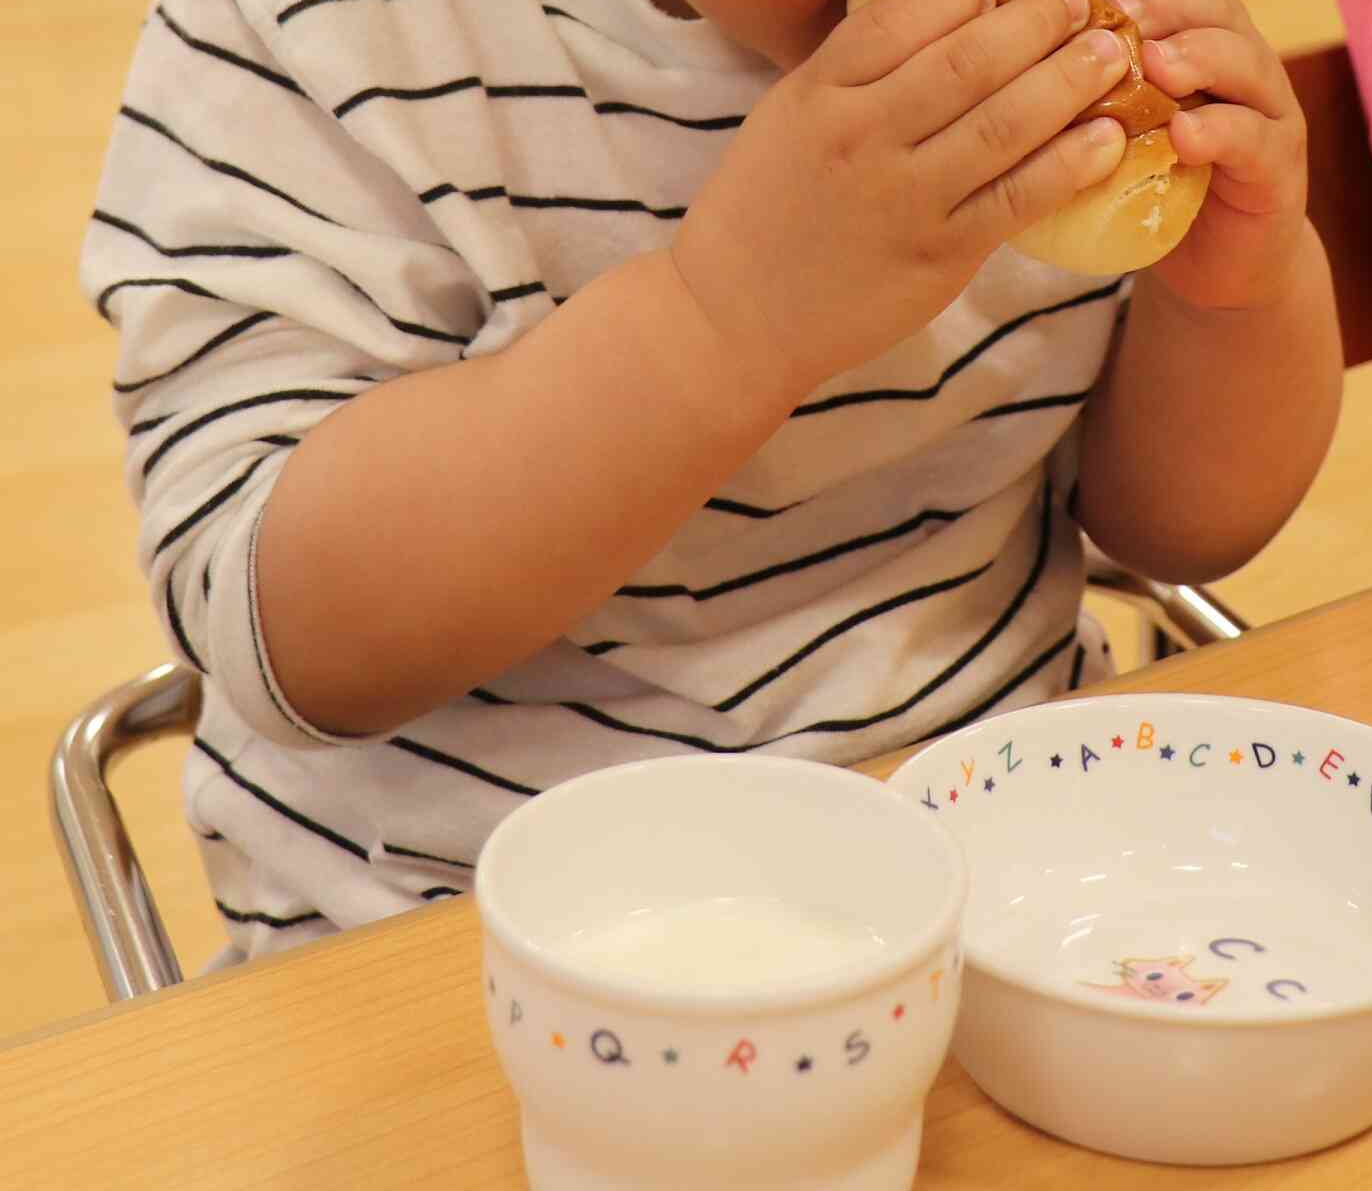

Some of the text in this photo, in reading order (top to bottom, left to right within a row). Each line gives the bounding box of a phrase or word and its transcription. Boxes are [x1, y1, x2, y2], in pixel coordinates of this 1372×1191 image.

[960, 759, 976, 787] Y
[997, 740, 1023, 774] Z
[1080, 743, 1101, 772] A
[1135, 721, 1156, 750] B
[1188, 743, 1212, 768] C
[1251, 742, 1276, 769] D
[1319, 749, 1345, 780] E
[589, 1028, 631, 1065] Q
[724, 1038, 758, 1074] R
[844, 1029, 871, 1066] S
